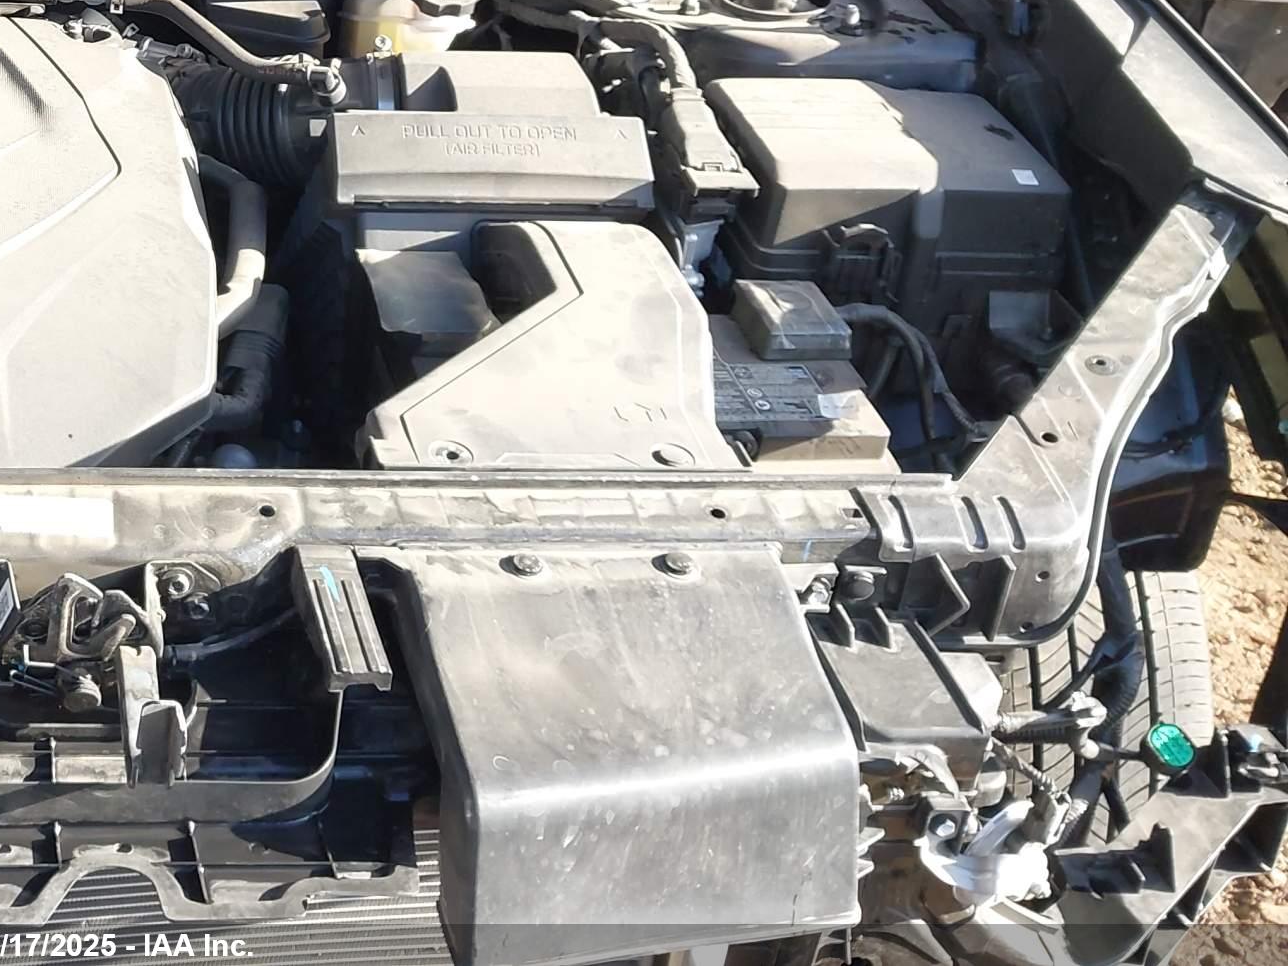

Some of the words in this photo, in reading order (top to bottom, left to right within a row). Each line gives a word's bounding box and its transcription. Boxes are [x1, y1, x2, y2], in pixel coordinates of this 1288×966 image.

[402, 124, 450, 138] PULL
[454, 124, 492, 139] OUT
[496, 124, 521, 139] TO
[525, 125, 577, 140] OPEN
